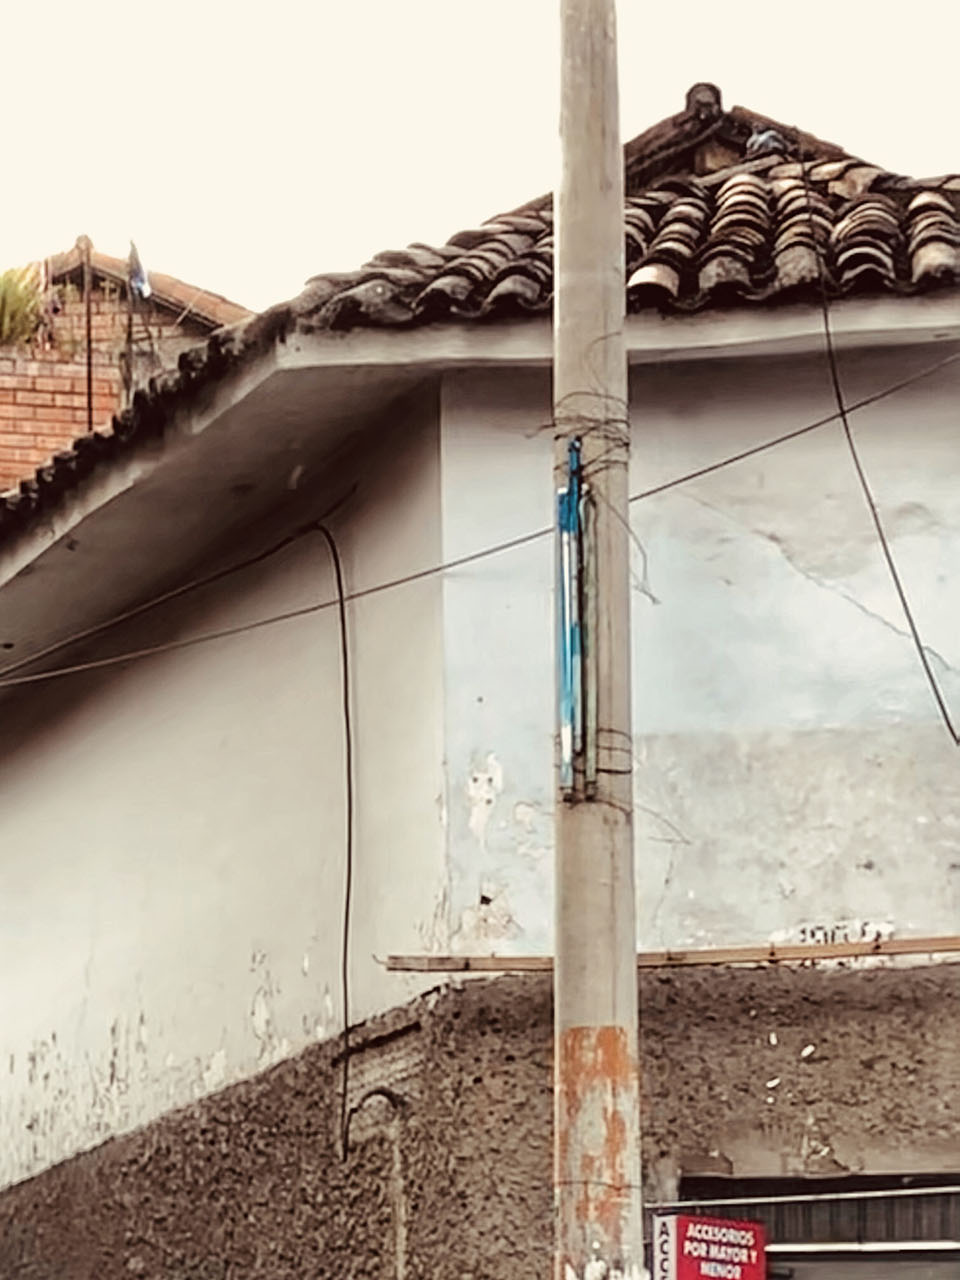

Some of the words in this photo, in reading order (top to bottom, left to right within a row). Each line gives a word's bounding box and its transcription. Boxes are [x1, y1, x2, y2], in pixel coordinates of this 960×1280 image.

[686, 1222, 756, 1247] ACCESORIOS
[683, 1240, 708, 1259] POR
[709, 1245, 746, 1264] MAYOR
[748, 1250, 758, 1265] Y
[700, 1261, 742, 1280] MENOR
